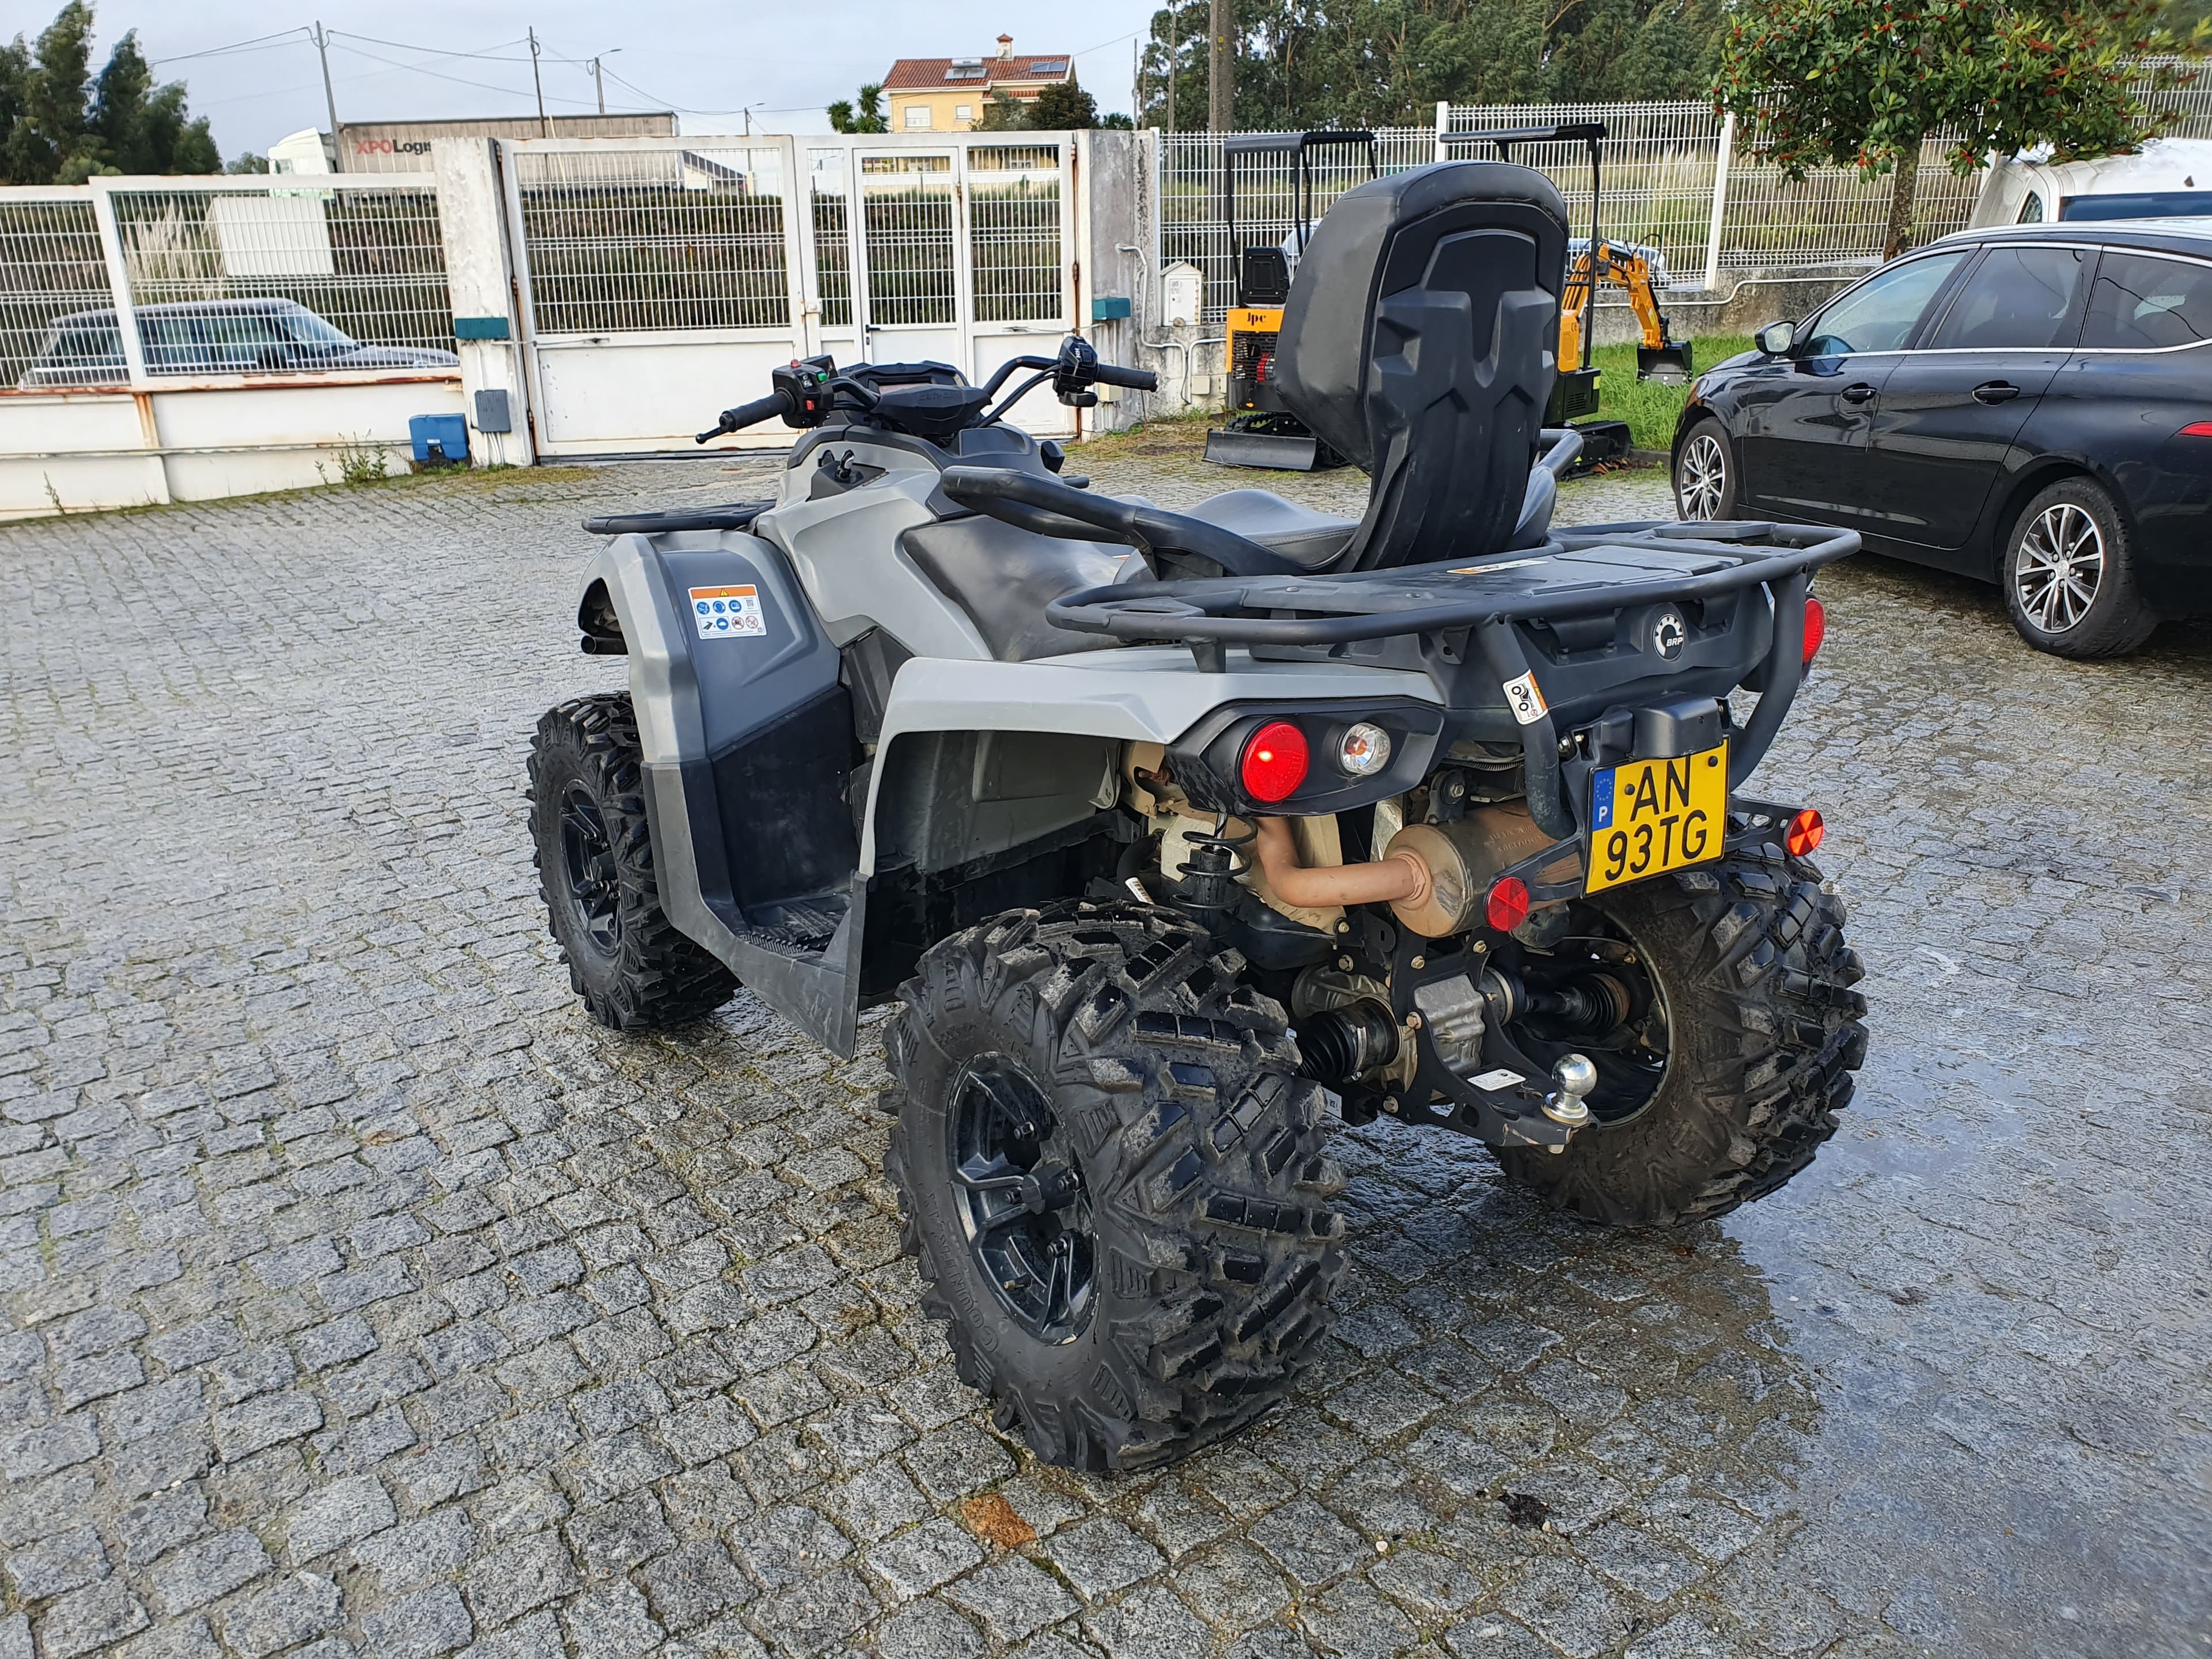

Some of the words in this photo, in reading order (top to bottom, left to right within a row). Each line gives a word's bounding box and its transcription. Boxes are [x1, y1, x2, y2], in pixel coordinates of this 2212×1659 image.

[1666, 637, 1683, 647] BRP
[1630, 754, 1691, 822] AN
[1599, 805, 1608, 823] P
